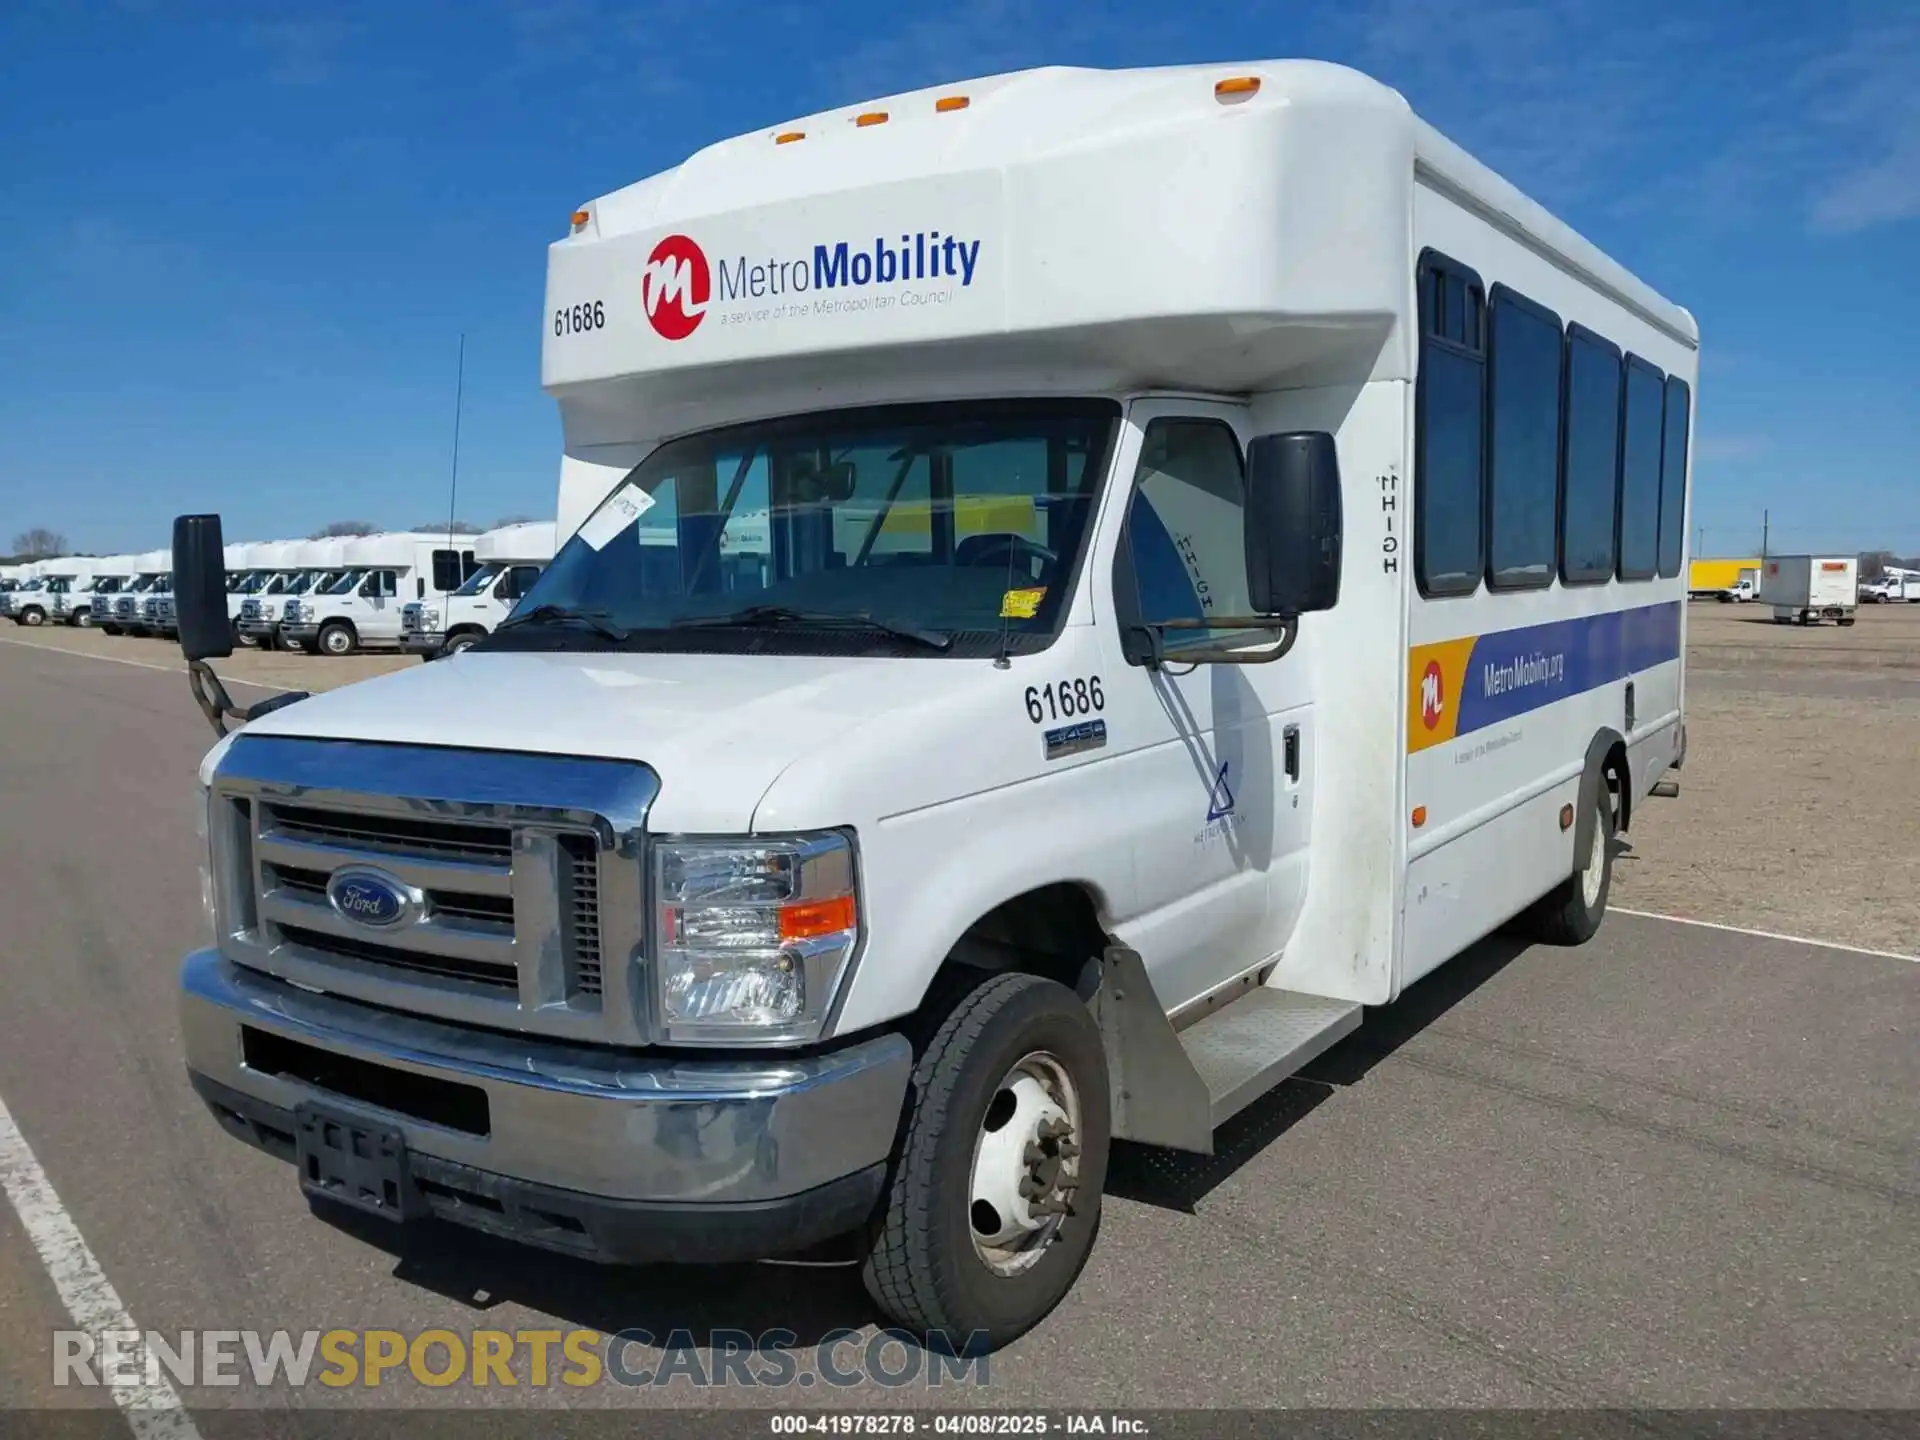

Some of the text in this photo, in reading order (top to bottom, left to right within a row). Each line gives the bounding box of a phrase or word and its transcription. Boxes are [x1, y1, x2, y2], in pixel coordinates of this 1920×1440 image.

[718, 230, 982, 301] MetroMobility
[554, 300, 605, 337] 61686
[720, 289, 954, 325] a service of the Metropolitan Council
[1484, 652, 1564, 700] MetroMobility.org
[1024, 675, 1105, 724] 61686
[343, 884, 382, 915] Ford
